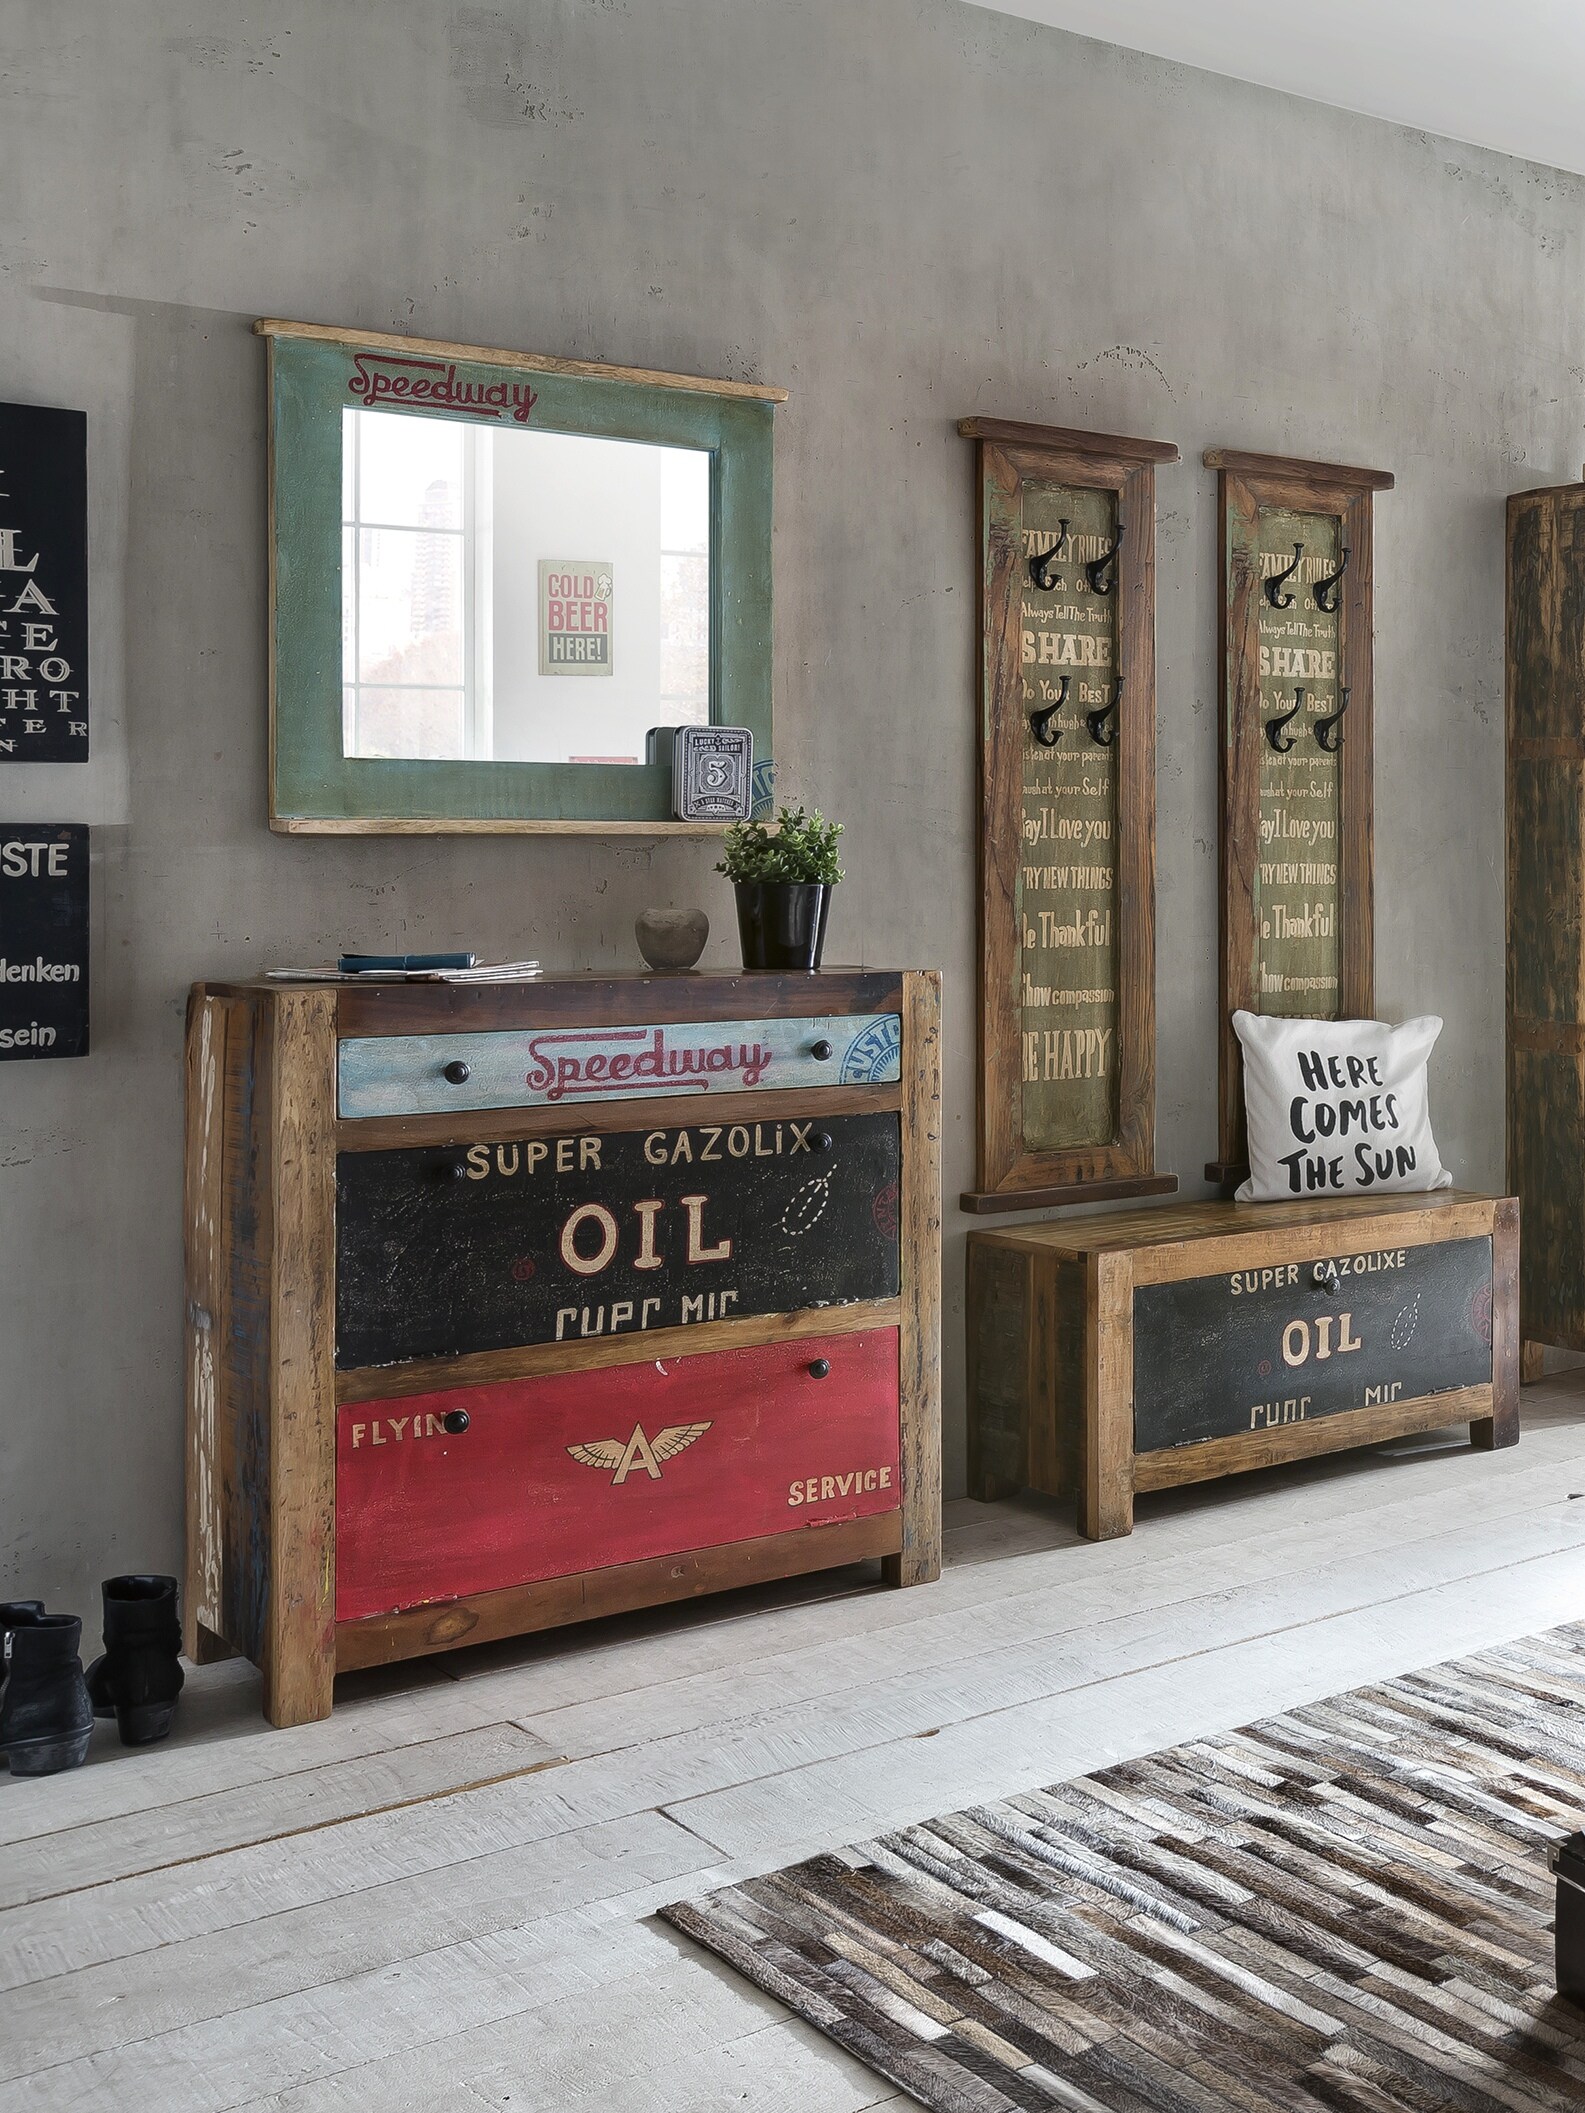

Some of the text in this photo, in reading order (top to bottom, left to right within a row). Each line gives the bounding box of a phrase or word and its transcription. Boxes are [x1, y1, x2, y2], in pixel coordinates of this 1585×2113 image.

[348, 353, 542, 422] Speedway
[548, 574, 594, 599] COLD
[548, 601, 608, 632] BEER
[553, 637, 601, 660] HERE!
[1022, 630, 1113, 667] SHARE
[1260, 645, 1336, 679] SHARE
[706, 760, 728, 788] 5
[1082, 777, 1110, 796] Self
[1309, 780, 1333, 799] Self
[1050, 807, 1082, 840] Love
[1080, 820, 1111, 848] you
[1282, 809, 1310, 839] Love
[1308, 820, 1335, 846] you
[1043, 866, 1069, 890] NEW
[1070, 866, 1114, 890] THINGS
[1276, 863, 1298, 885] NEW
[1299, 863, 1337, 885] THINGS
[1038, 909, 1111, 949] Thankful
[1272, 902, 1334, 939] Thankful
[526, 1028, 773, 1101] Speedway
[1044, 1026, 1112, 1081] HAPPY
[1297, 1050, 1384, 1092] HERE
[1289, 1093, 1399, 1144] COMES
[466, 1137, 602, 1181] SUPER
[1276, 1142, 1418, 1194] THE SUN
[558, 1194, 734, 1276] OIL
[1230, 1264, 1299, 1296] SUPER
[1283, 1313, 1362, 1367] OIL
[352, 1408, 470, 1449] FLYIN
[787, 1465, 892, 1508] SERVICE
